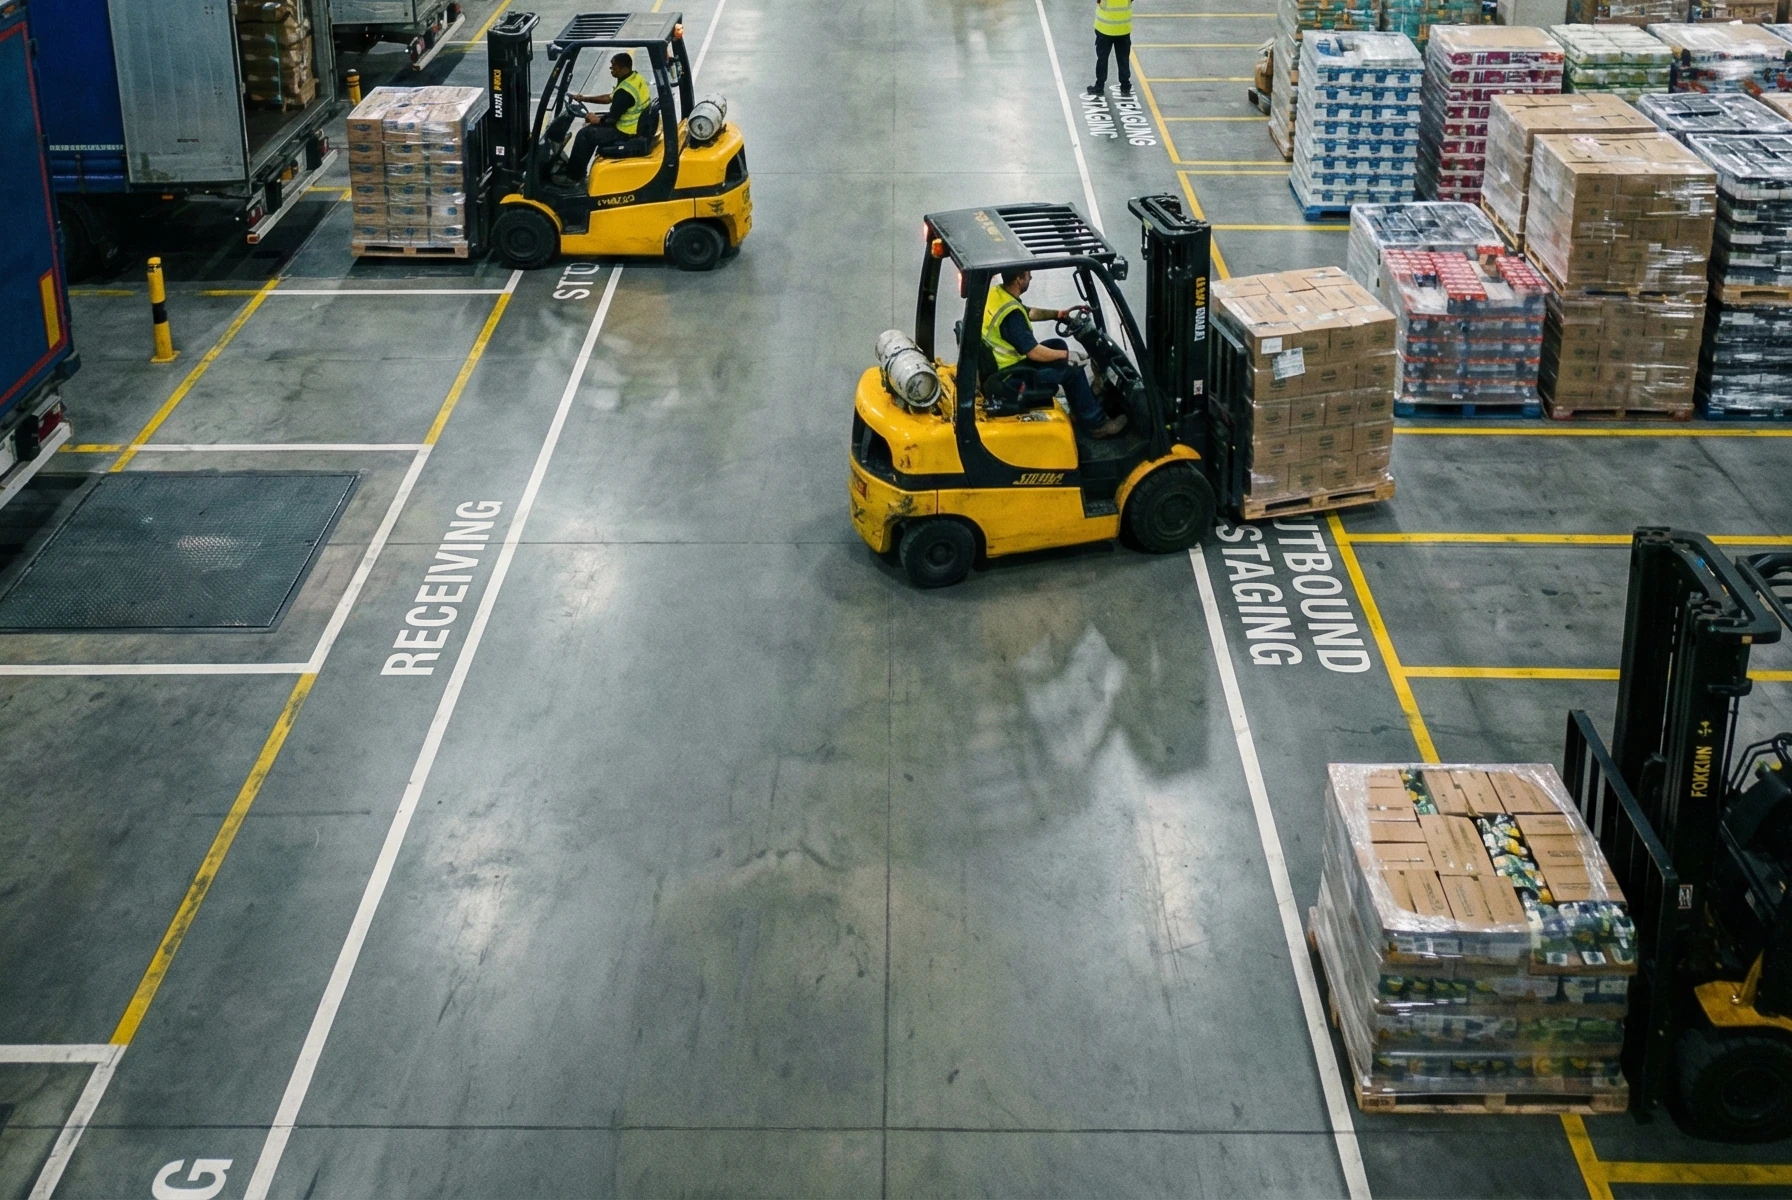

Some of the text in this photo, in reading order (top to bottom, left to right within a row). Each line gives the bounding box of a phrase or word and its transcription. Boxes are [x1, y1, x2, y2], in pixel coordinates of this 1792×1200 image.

[379, 500, 503, 676] RECEIVING
[1215, 524, 1303, 666] STAGING
[1273, 514, 1371, 674] UTBOUND
